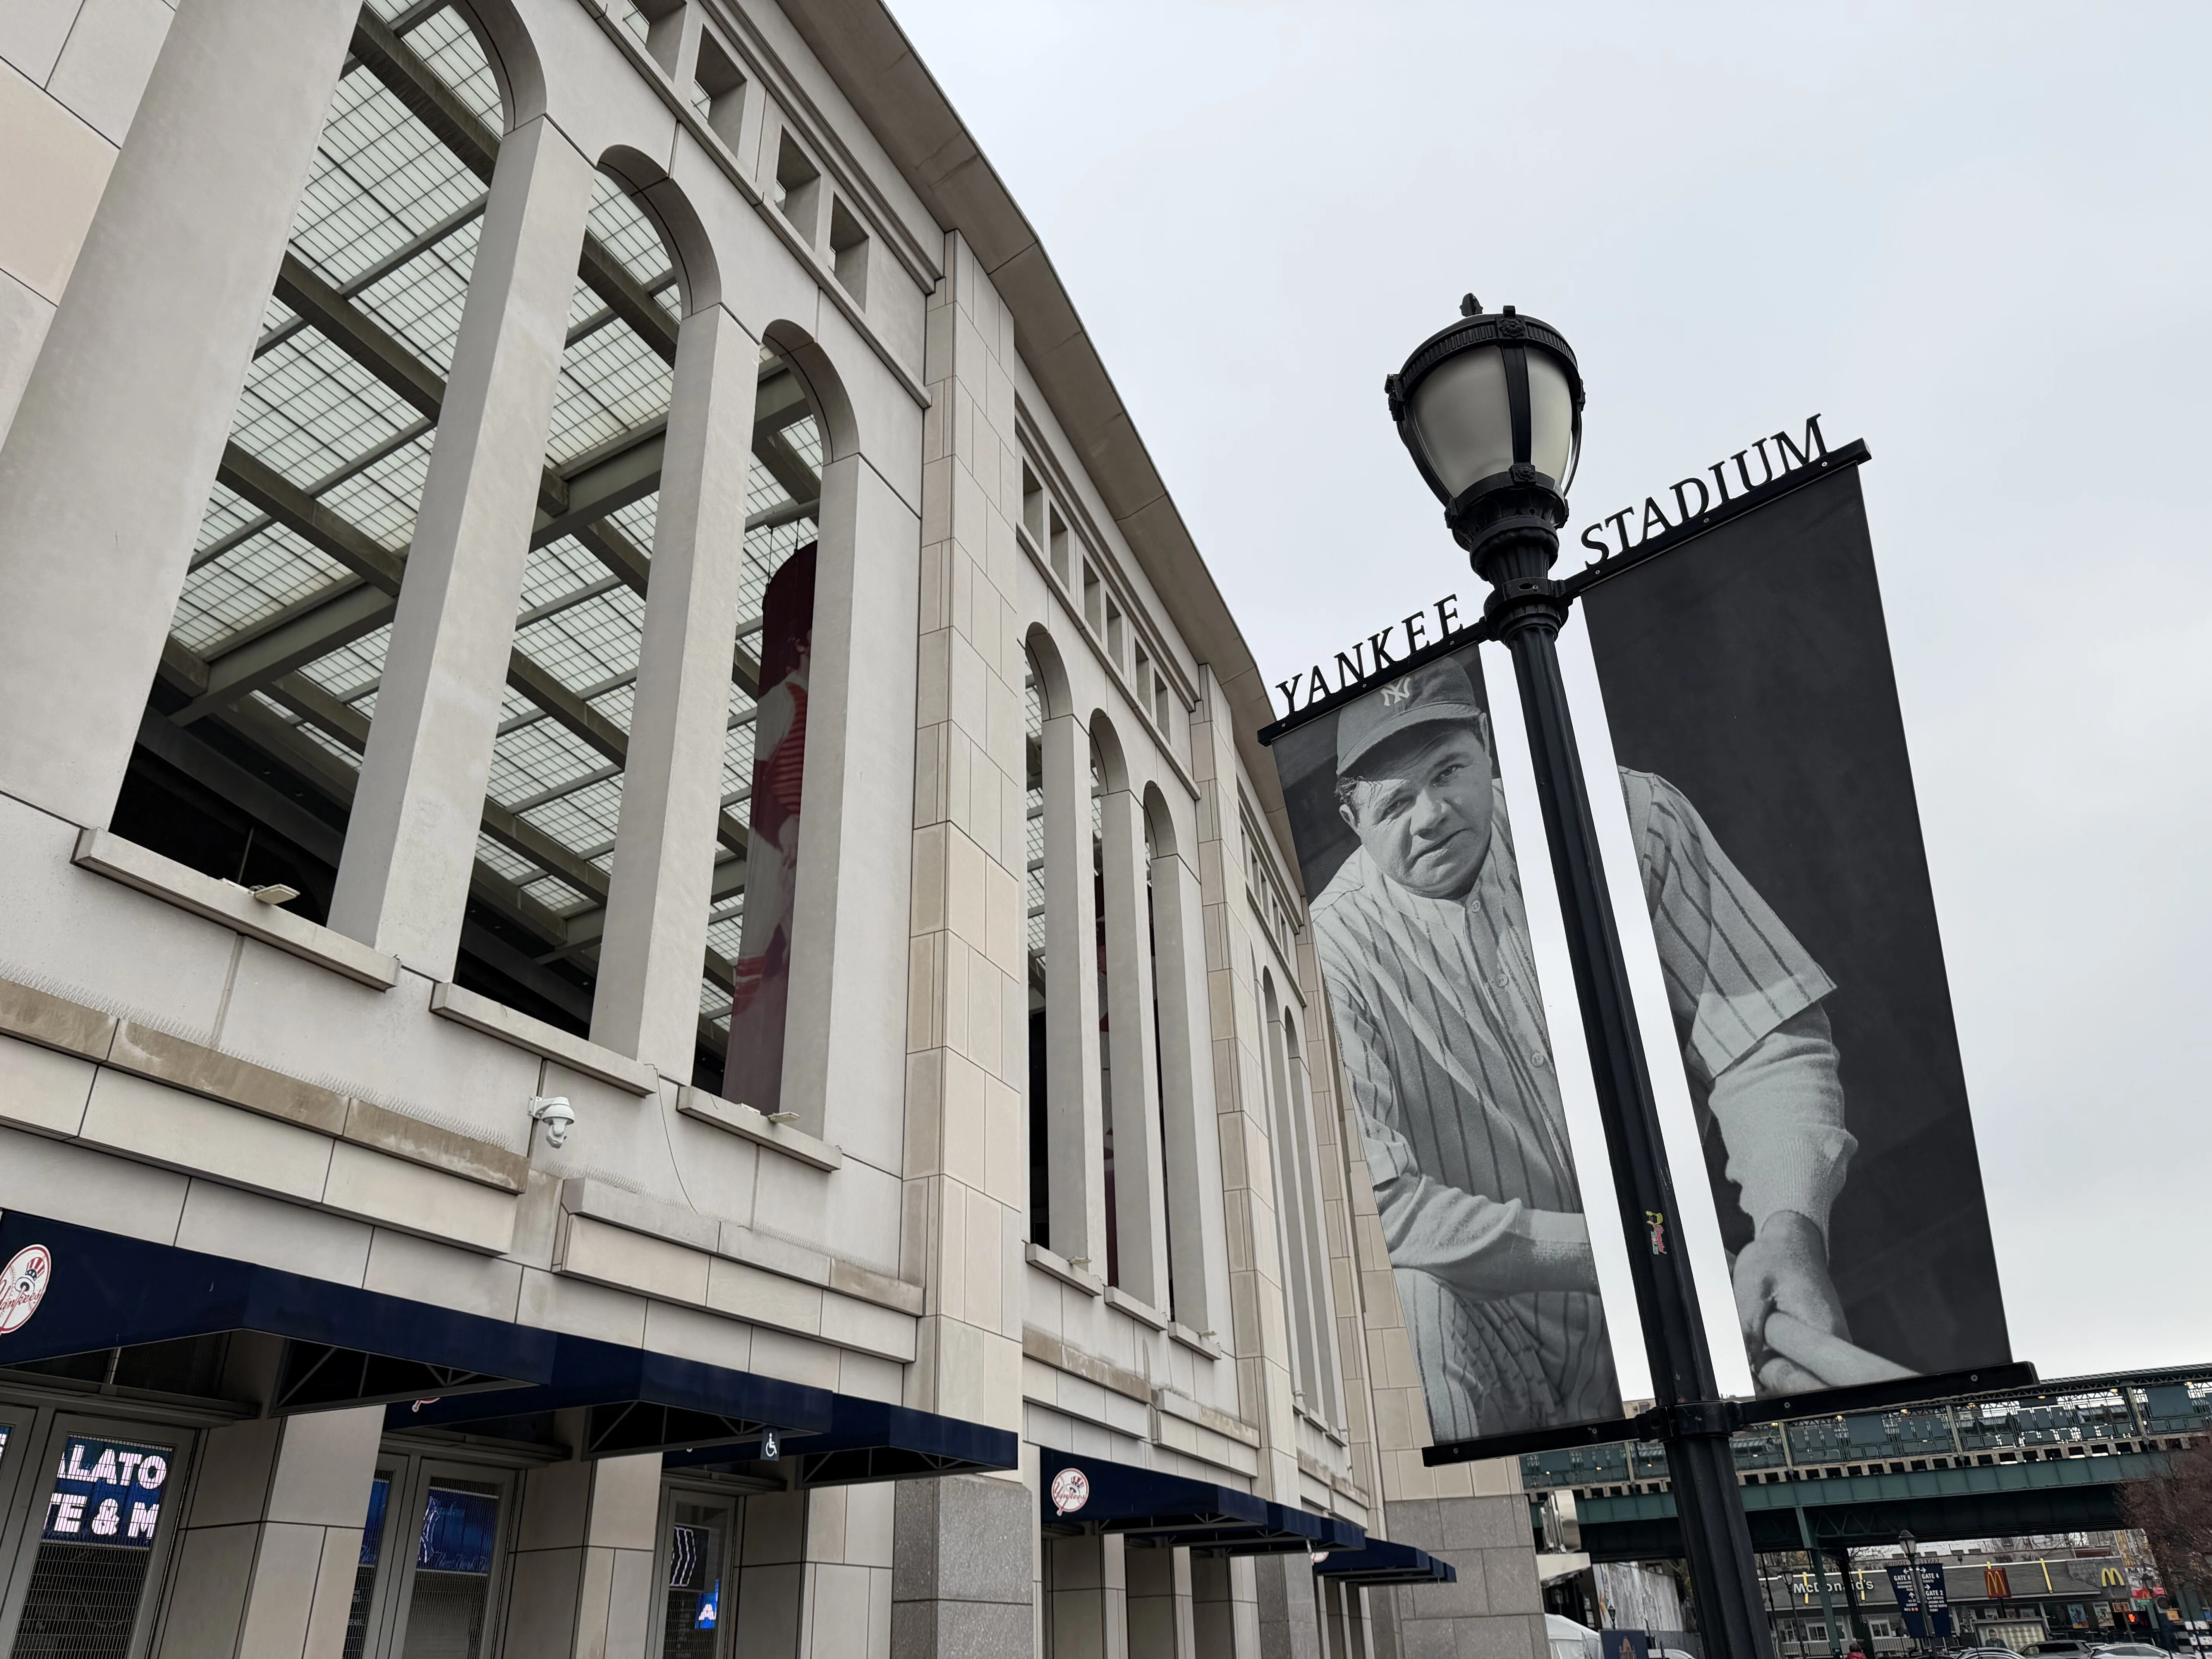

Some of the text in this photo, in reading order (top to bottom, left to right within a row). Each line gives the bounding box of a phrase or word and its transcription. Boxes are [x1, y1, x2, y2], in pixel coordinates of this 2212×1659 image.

[1275, 413, 1834, 715] YANKEE STADIUM
[92, 1498, 120, 1537] &
